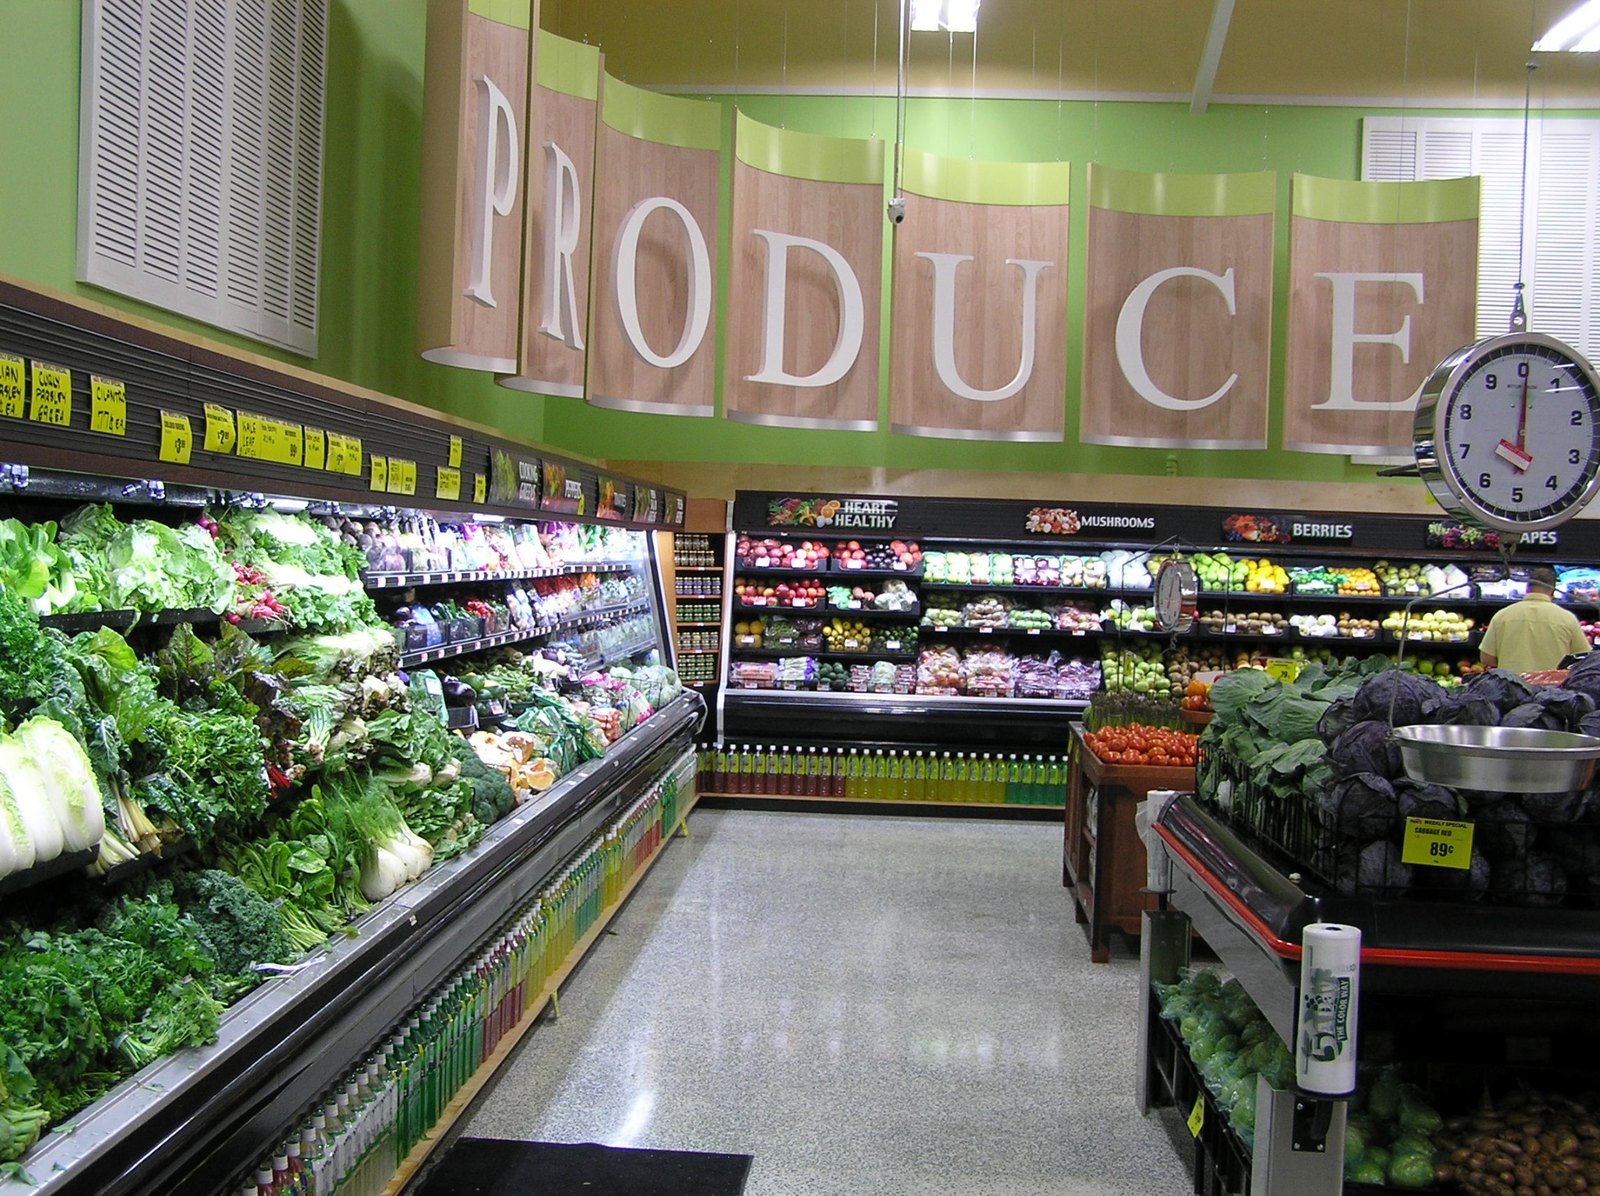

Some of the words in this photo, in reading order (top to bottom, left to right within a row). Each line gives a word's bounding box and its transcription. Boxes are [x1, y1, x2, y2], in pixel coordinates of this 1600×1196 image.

[463, 74, 1424, 413] PRODUCE
[0, 364, 19, 384] IAN
[1518, 363, 1529, 378] 0
[1485, 374, 1497, 389] 9
[1550, 378, 1560, 393] 1
[1460, 404, 1472, 420] 8
[1571, 411, 1582, 426] 2
[1460, 444, 1470, 459] 7
[1569, 449, 1580, 464] 3
[1479, 473, 1491, 488] 6
[1545, 475, 1557, 490] 4
[1512, 488, 1523, 502] 5
[844, 501, 887, 514] HEART
[834, 514, 896, 528] HEALTHY
[1081, 516, 1155, 528] MUSHROOMS
[1293, 523, 1352, 538] BERRIES
[1519, 531, 1557, 544] APES
[1340, 980, 1349, 998] WAY
[1337, 999, 1347, 1023] COLOR
[1337, 1026, 1345, 1041] THE
[1311, 1034, 1340, 1060] 5
